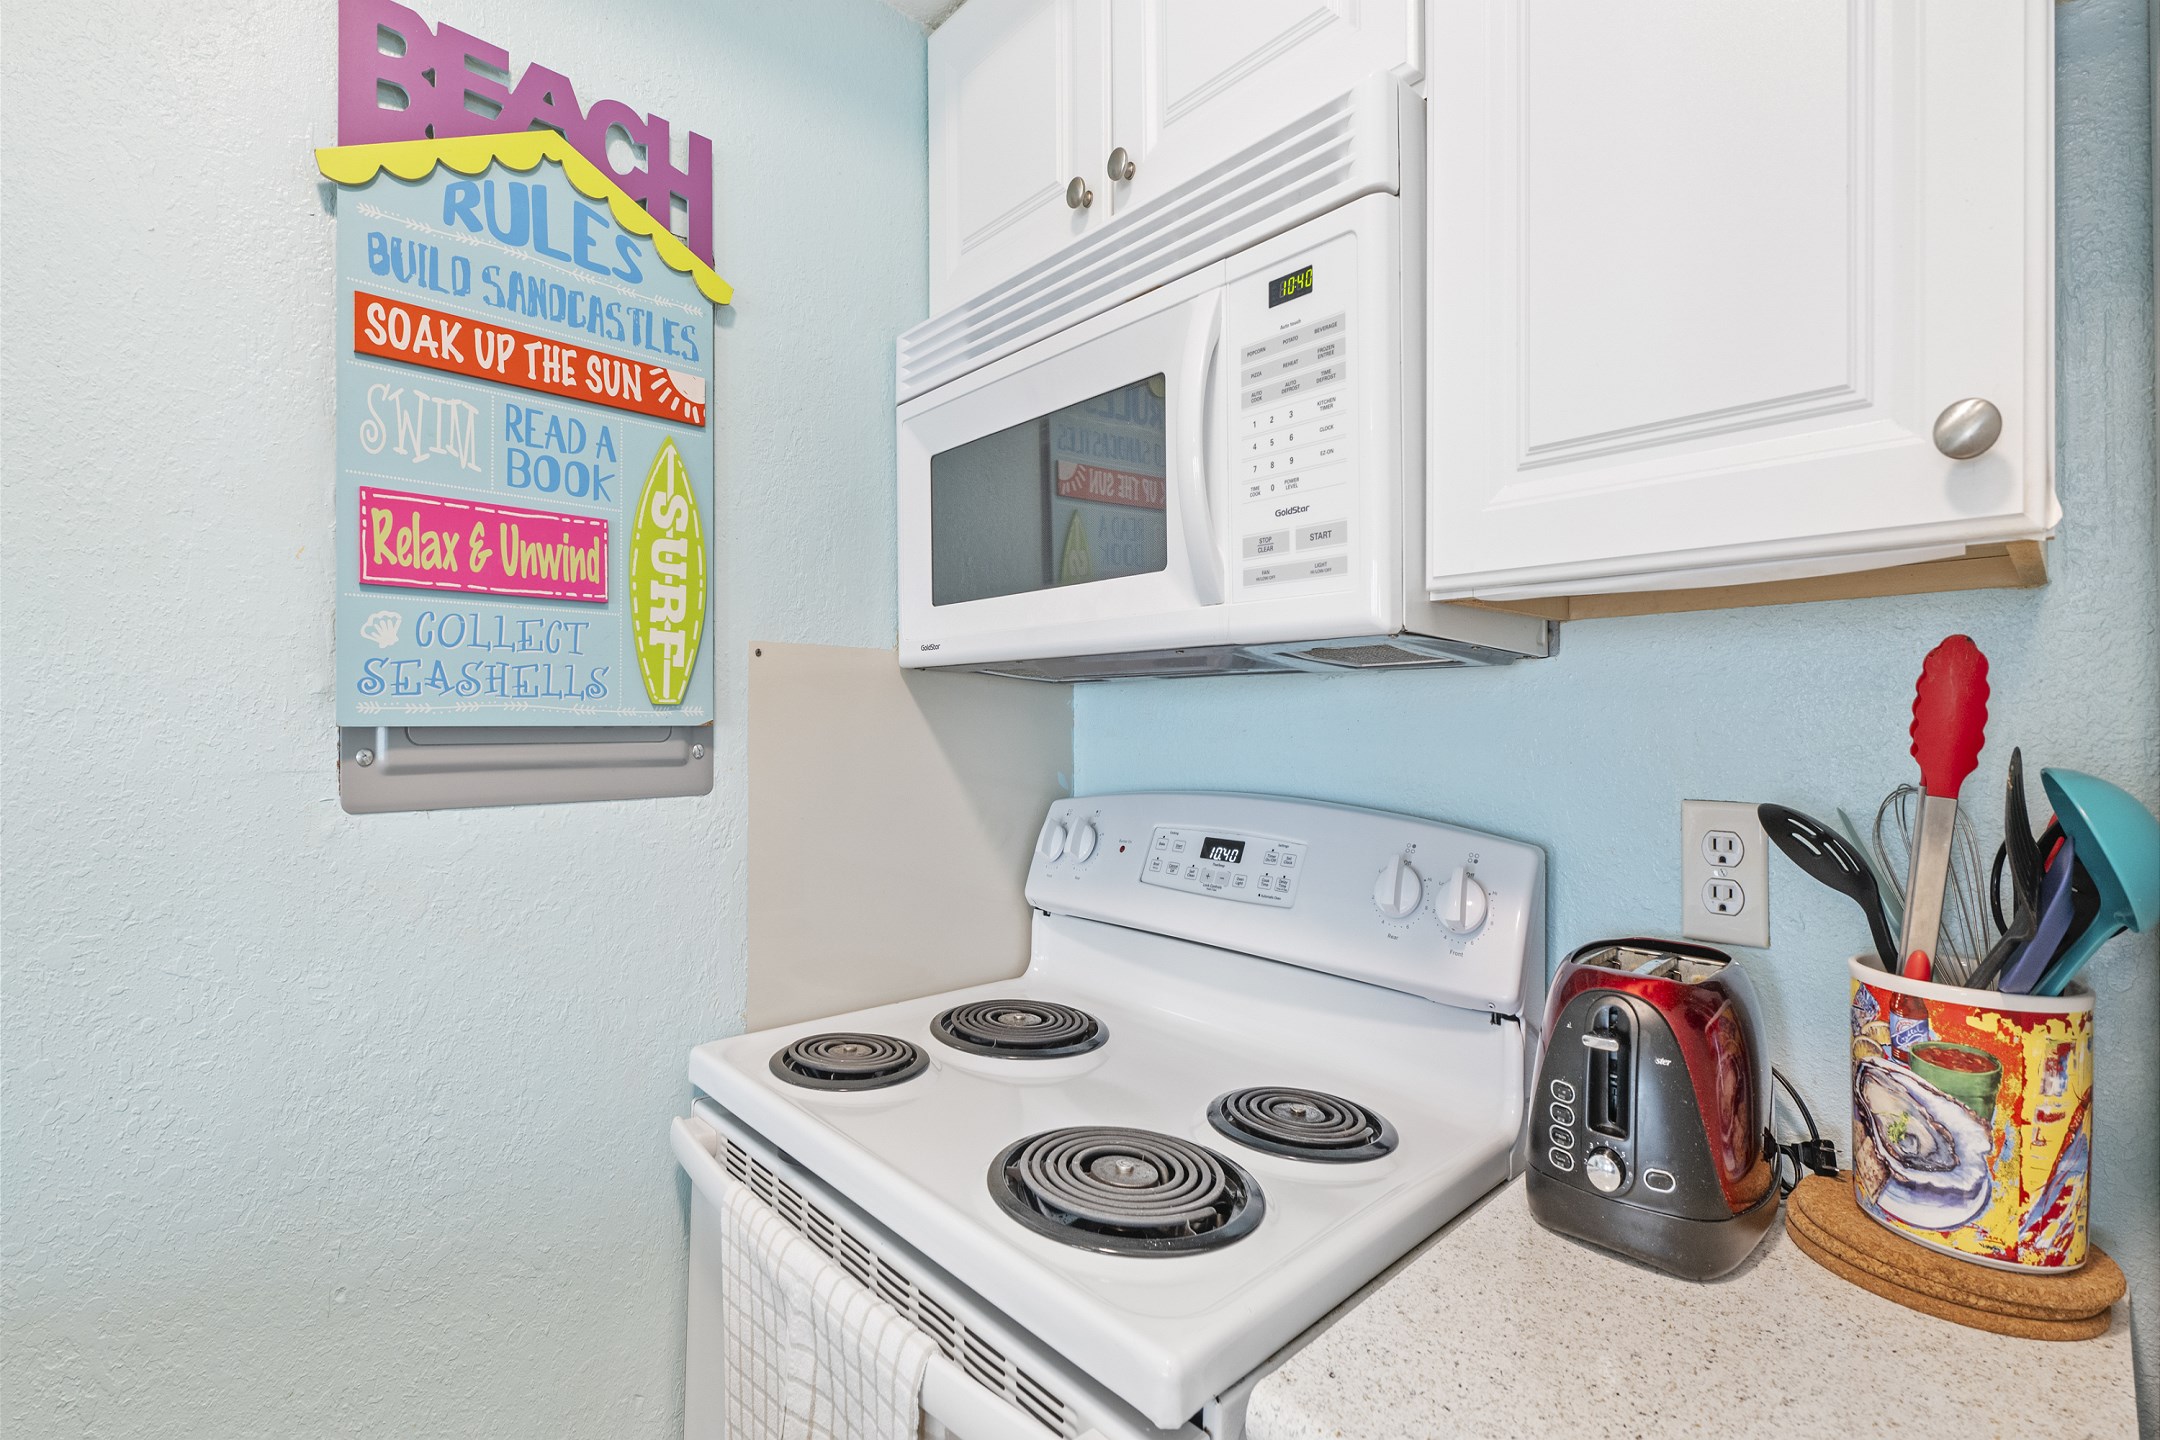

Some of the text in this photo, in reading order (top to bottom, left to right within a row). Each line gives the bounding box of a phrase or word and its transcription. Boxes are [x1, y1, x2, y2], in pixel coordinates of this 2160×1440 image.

[338, 0, 713, 270] BEACH
[443, 180, 644, 284] RULES
[1282, 268, 1313, 296] 10:40
[367, 231, 700, 363] BUILD SANDCASTLES
[1314, 321, 1338, 334] BEVERAGE
[1282, 335, 1299, 345] POTATO
[364, 302, 642, 401] SOAK UP THE SUN
[1246, 346, 1266, 358] POPCORN
[1317, 343, 1335, 354] FROZEN
[1282, 359, 1299, 368] REHEAT
[1250, 371, 1262, 379] PIZZA
[1320, 368, 1332, 376] TIME
[1284, 379, 1297, 388] AUTO
[1316, 373, 1336, 384] DEFROST
[1281, 384, 1300, 394] DEFROST
[1250, 396, 1263, 404] COOK
[1317, 396, 1336, 407] KITCHEN
[1319, 403, 1334, 411] TIMER
[1253, 410, 1293, 428] 1 2 3
[360, 382, 482, 473] SWIM
[505, 404, 617, 462] READ A
[1319, 424, 1334, 433] CLOCK
[1252, 433, 1294, 451] 4 5 6
[1253, 457, 1294, 473] 7 8 9
[507, 447, 615, 502] BOOK
[1284, 477, 1300, 485] POWER
[1285, 482, 1299, 491] LEVEL
[1270, 484, 1275, 492] 0
[1275, 504, 1311, 518] GoldStar
[1258, 536, 1273, 545] STOP
[1309, 529, 1332, 542] START
[372, 507, 600, 584] Relax & Unwind
[1257, 545, 1274, 554] CLEAR
[1314, 561, 1328, 569] LIGHT
[649, 491, 689, 669] SURF
[415, 611, 591, 656] COLLECT
[357, 656, 610, 702] SEASHELLS
[1387, 932, 1399, 941] Rear
[1449, 949, 1464, 958] Front
